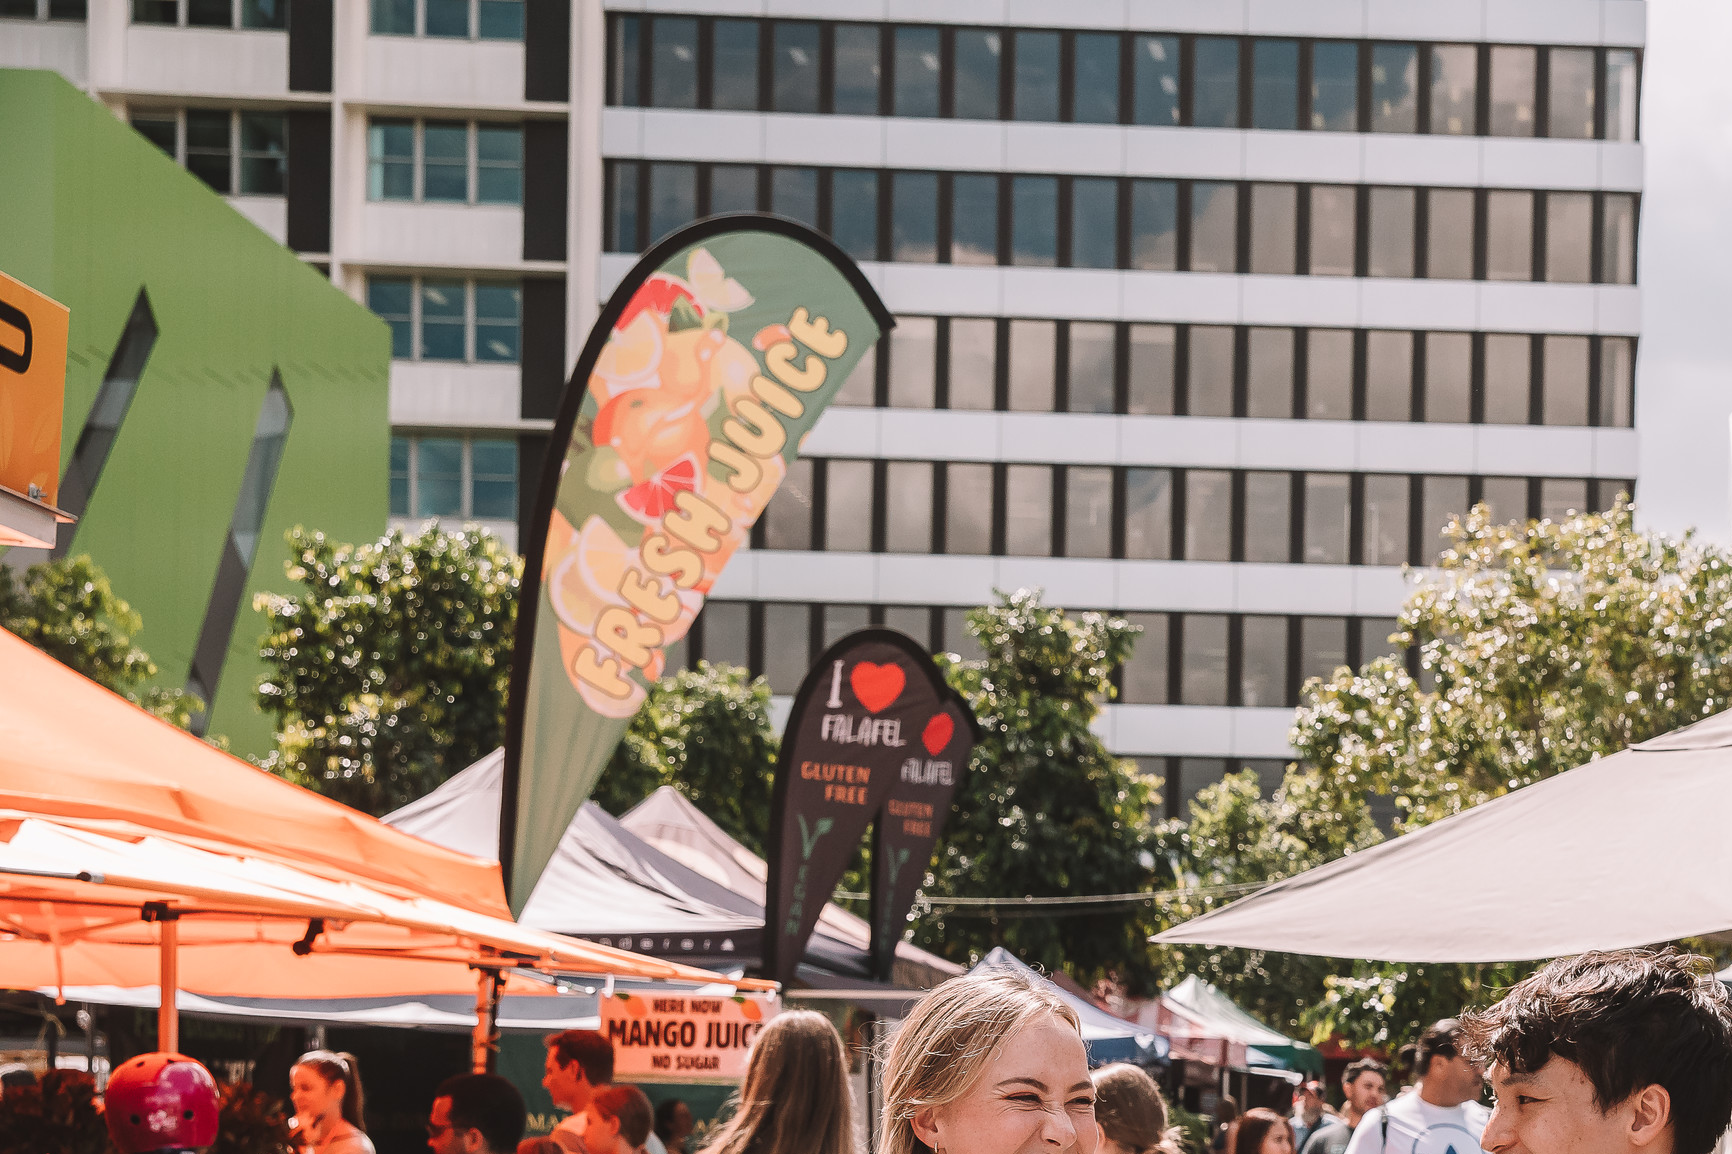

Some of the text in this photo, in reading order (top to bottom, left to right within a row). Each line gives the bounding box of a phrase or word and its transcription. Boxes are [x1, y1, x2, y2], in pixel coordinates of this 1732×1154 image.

[571, 305, 849, 700] FRESH JUICE
[825, 659, 846, 709] I
[820, 713, 908, 748] FALAFEL
[800, 760, 872, 785] GLUTEN
[824, 784, 869, 806] FREE
[652, 999, 723, 1014] HERE NOW
[608, 1019, 696, 1048] MANGO
[652, 1055, 720, 1070] NO SUGAR
